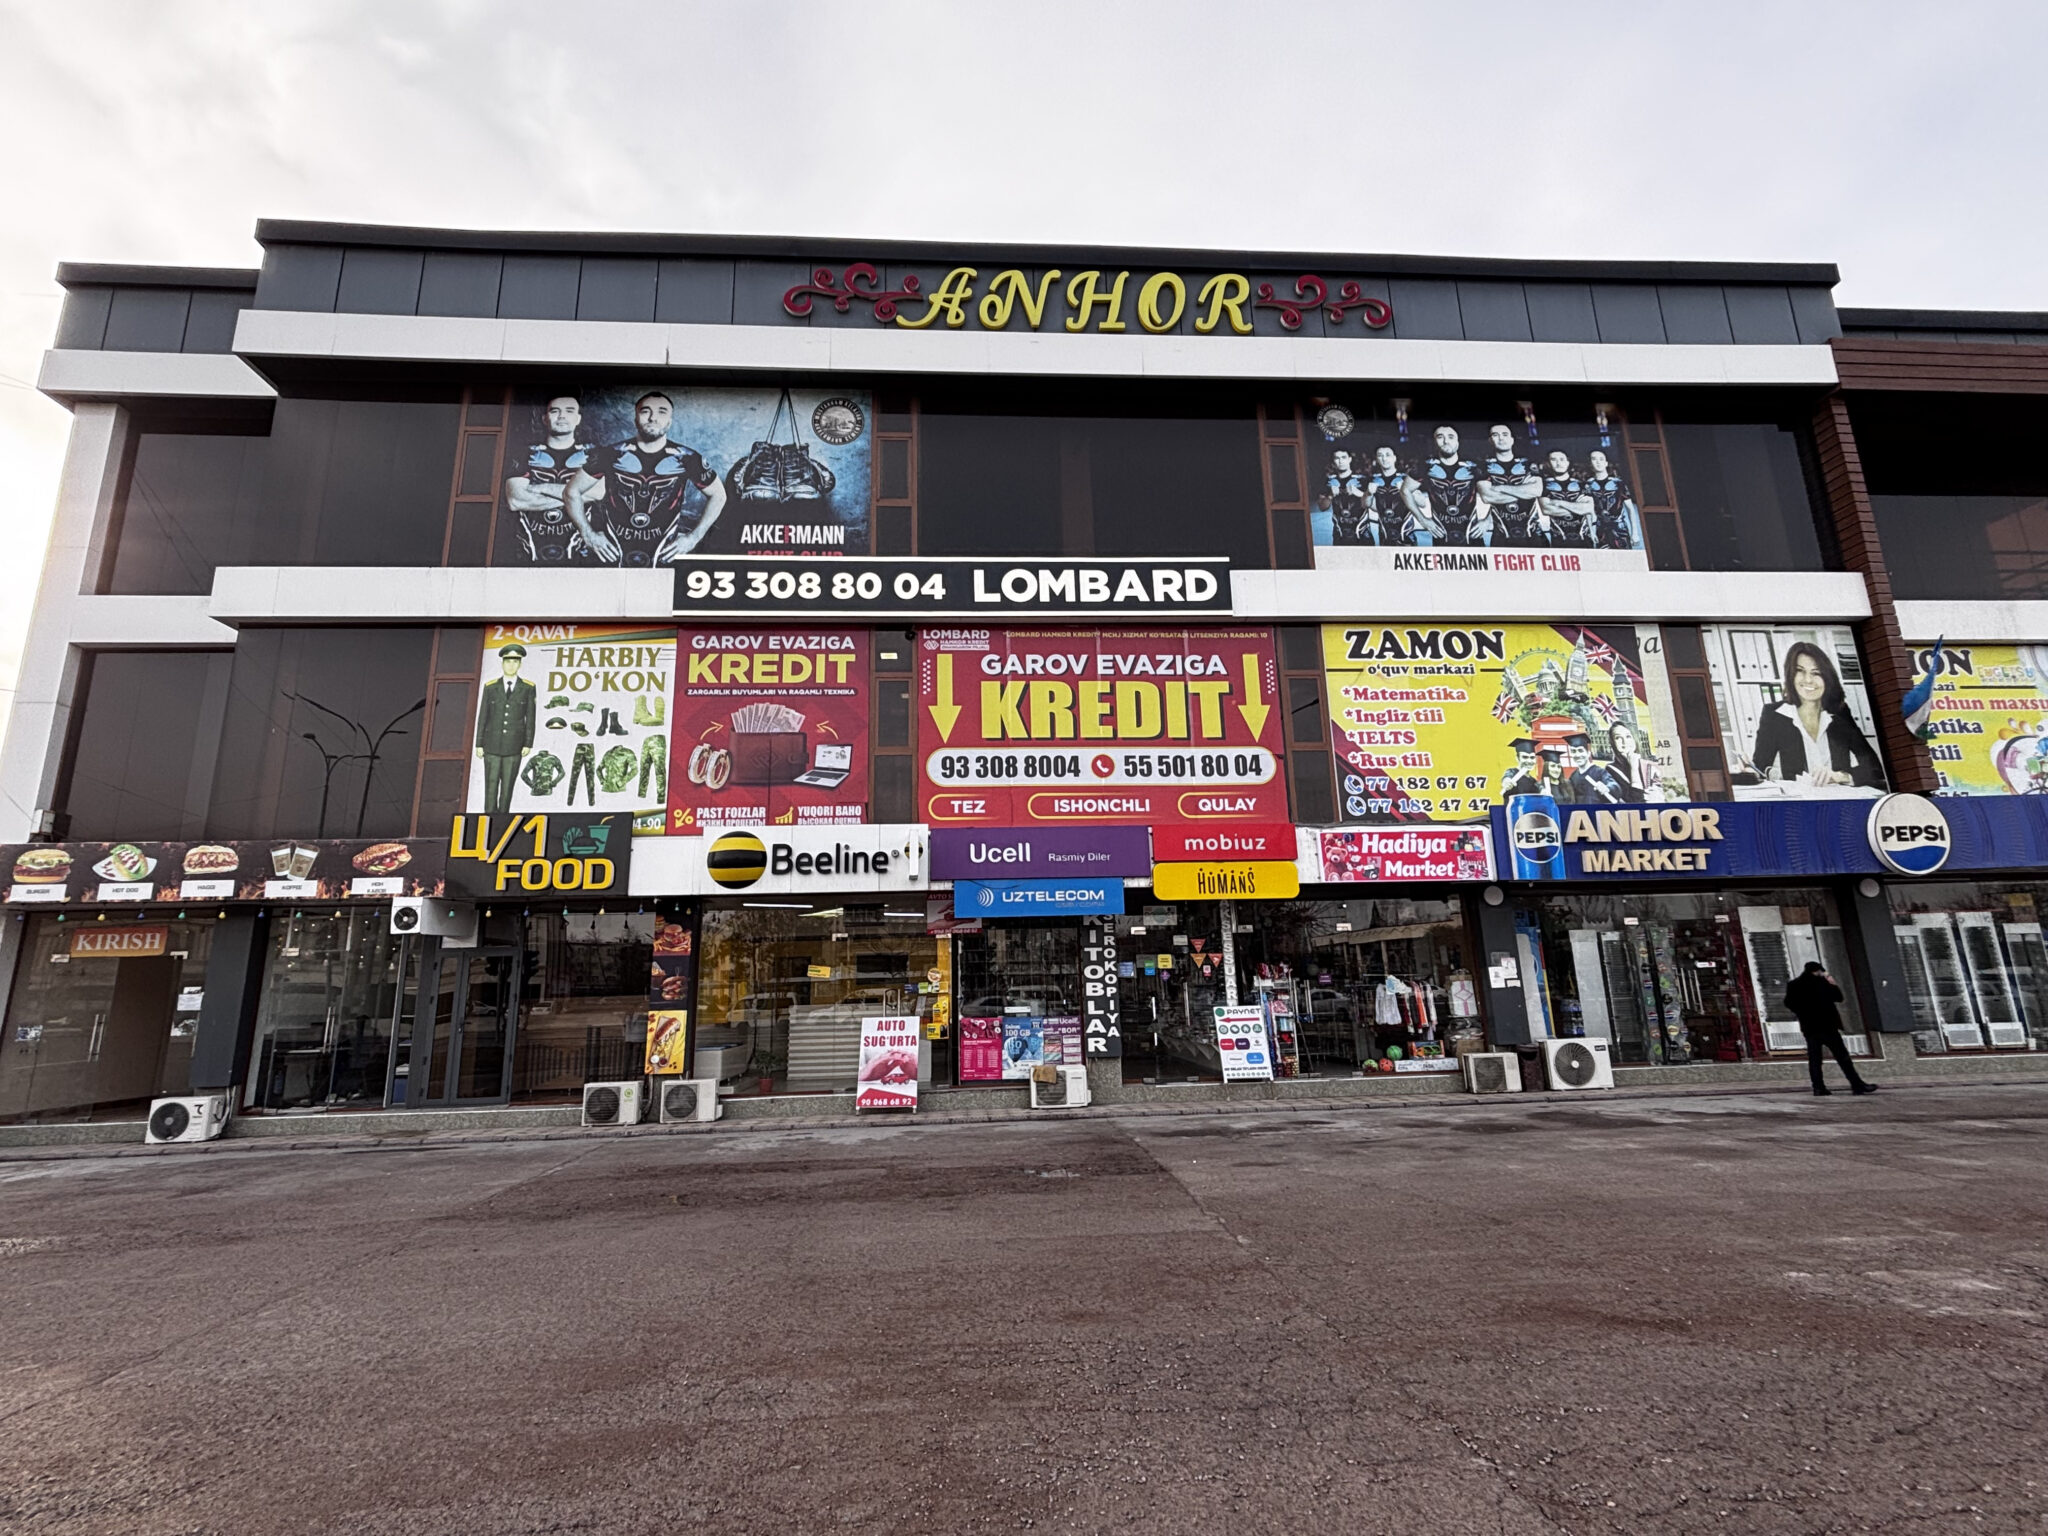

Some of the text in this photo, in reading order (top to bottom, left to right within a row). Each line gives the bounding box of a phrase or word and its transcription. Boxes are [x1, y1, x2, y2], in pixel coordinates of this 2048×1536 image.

[896, 267, 1253, 334] ANHOR
[740, 524, 844, 545] AKKERMANN
[1394, 553, 1582, 572] AKKERMANN FIGHT CLUB
[686, 568, 1218, 602] 93 308 80 04 LOMBARD
[492, 625, 578, 643] 2-QAVAT
[691, 635, 856, 650] GAROV EVAZIGA
[923, 629, 991, 639] LOMBARD
[1345, 630, 1504, 660] ZAMON
[555, 647, 662, 668] HARBIY
[980, 654, 1228, 676] GAROV EVAZIGA
[688, 653, 856, 684] KREDIT
[1413, 663, 1476, 675] markazi
[687, 688, 731, 696] ZARGARLIK
[732, 688, 776, 696] BUYUMLARI
[1353, 687, 1467, 701] Matematika
[980, 680, 1232, 740] KREDIT
[1355, 709, 1444, 726] Ingliz tili
[1357, 731, 1416, 745] IELTS
[941, 754, 1081, 779] 93 308 8004
[1124, 754, 1263, 777] 55 501 80 04
[1360, 753, 1431, 767] Rus tili
[1365, 777, 1487, 790] 77 182 67 67
[696, 805, 862, 819] PAST FOIZLAR YUQORI BAHO
[950, 800, 986, 814] TEZ
[1053, 798, 1151, 813] ISHONCHLI
[1198, 797, 1257, 812] QULAY
[1368, 799, 1491, 812] 77 182 47 47
[1563, 807, 1724, 843] ANHOR
[1880, 825, 1946, 842] PEPSI
[1184, 833, 1267, 851] mobiuz
[1361, 832, 1447, 855] Hadiya
[1516, 831, 1560, 845] PEPSI
[771, 842, 890, 875] Beeline
[969, 843, 1112, 863] Ucell Rasmiy Diler
[1582, 847, 1711, 873] MARKET
[495, 857, 615, 891] FOOD
[1384, 860, 1456, 877] Market
[1002, 889, 1105, 903] UZTELECOM
[75, 932, 162, 950] KIRISH
[876, 1020, 906, 1032] AUTO
